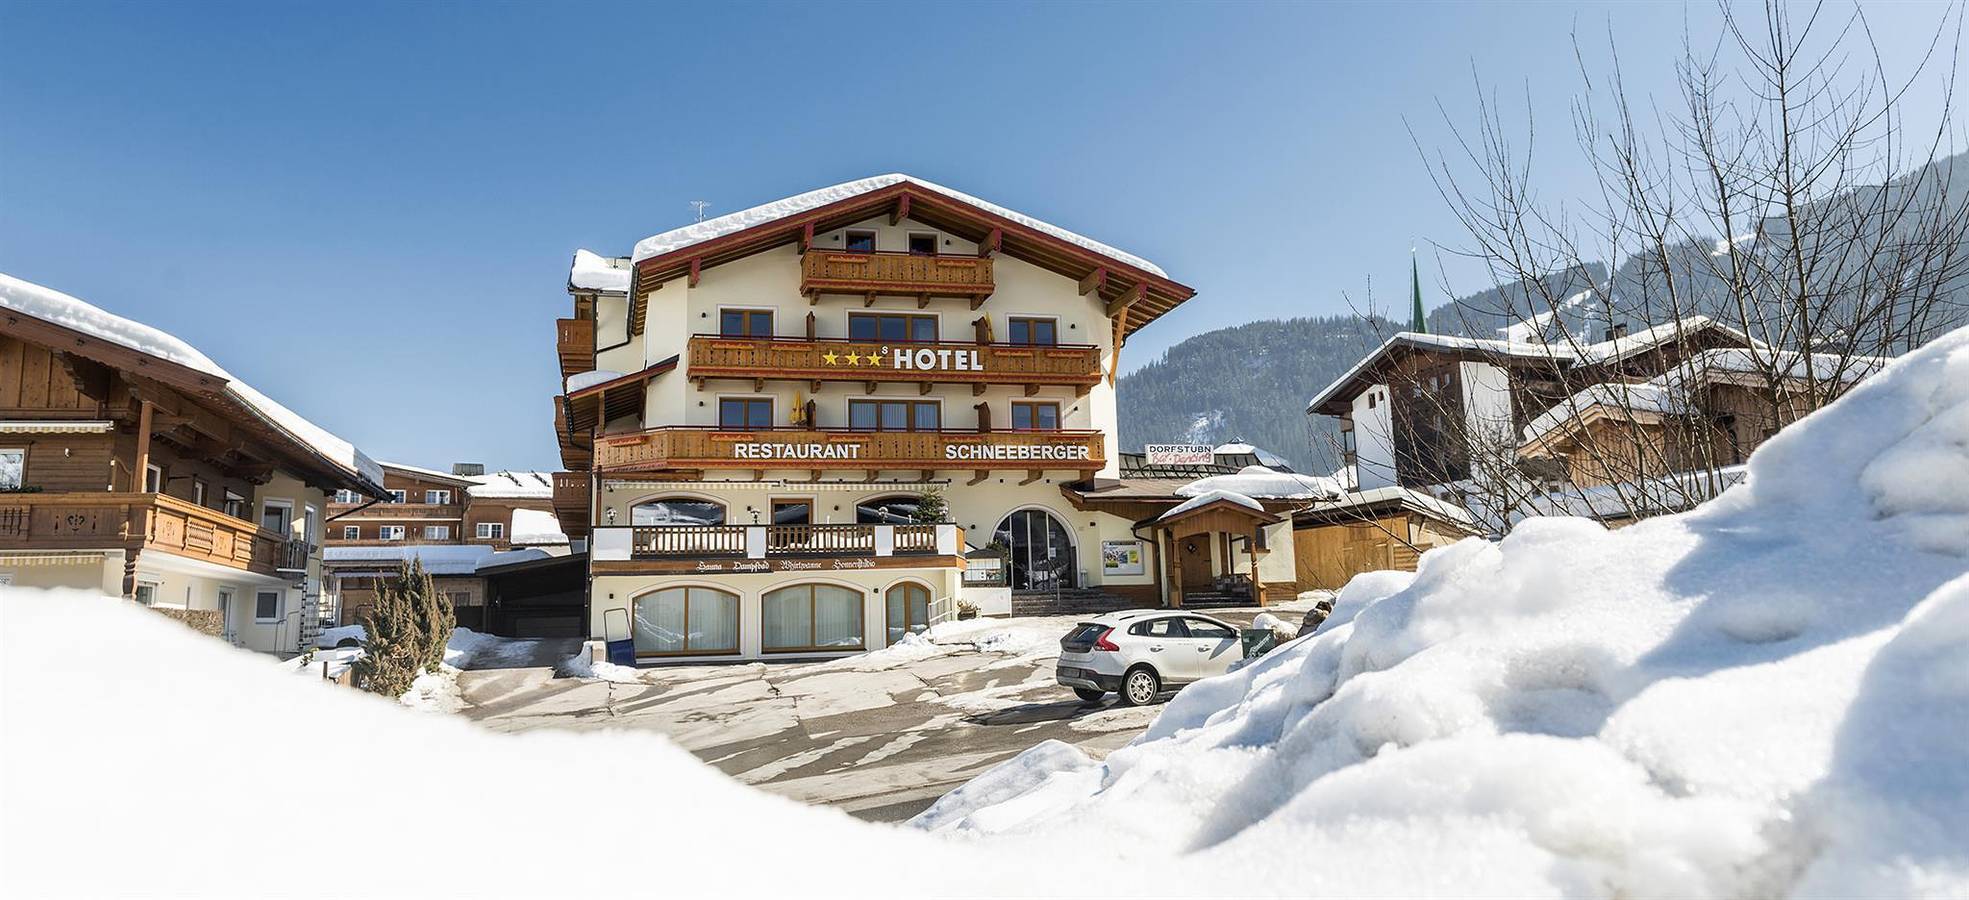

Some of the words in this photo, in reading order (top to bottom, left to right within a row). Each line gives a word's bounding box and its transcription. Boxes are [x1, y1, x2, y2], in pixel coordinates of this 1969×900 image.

[894, 348, 983, 371] HOTEL
[734, 443, 861, 459] RESTAURANT
[945, 444, 1089, 460] SCHNEEBERGER
[1149, 445, 1212, 453] DORFSTUBN
[696, 561, 722, 572] Sauna
[733, 561, 770, 573] Dampfbad
